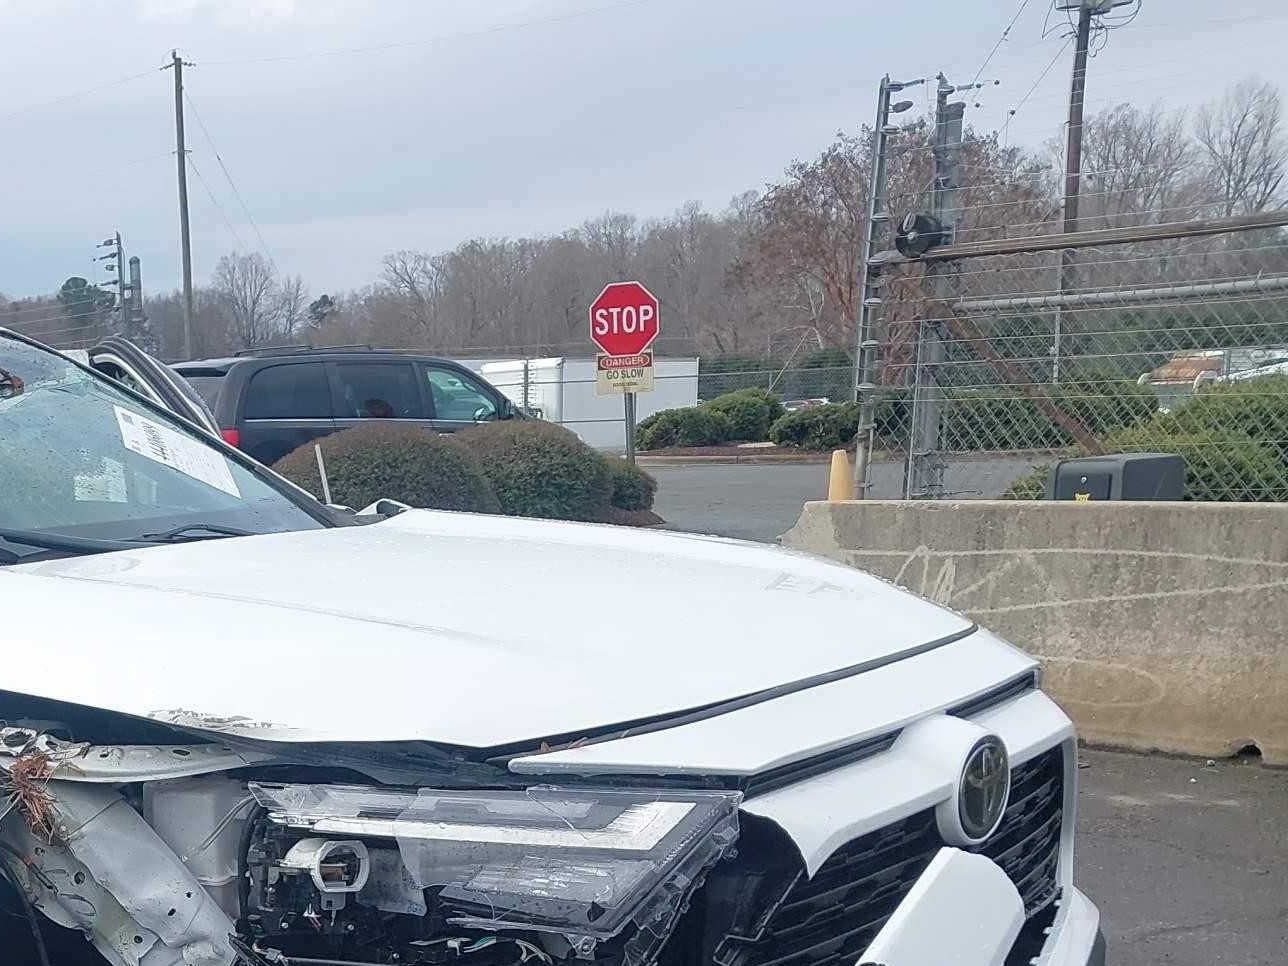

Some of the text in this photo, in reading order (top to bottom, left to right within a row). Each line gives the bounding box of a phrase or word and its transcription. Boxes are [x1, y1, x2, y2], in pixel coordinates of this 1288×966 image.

[595, 305, 653, 335] STOP
[605, 356, 644, 367] DANGER
[606, 368, 644, 380] GO SLOW
